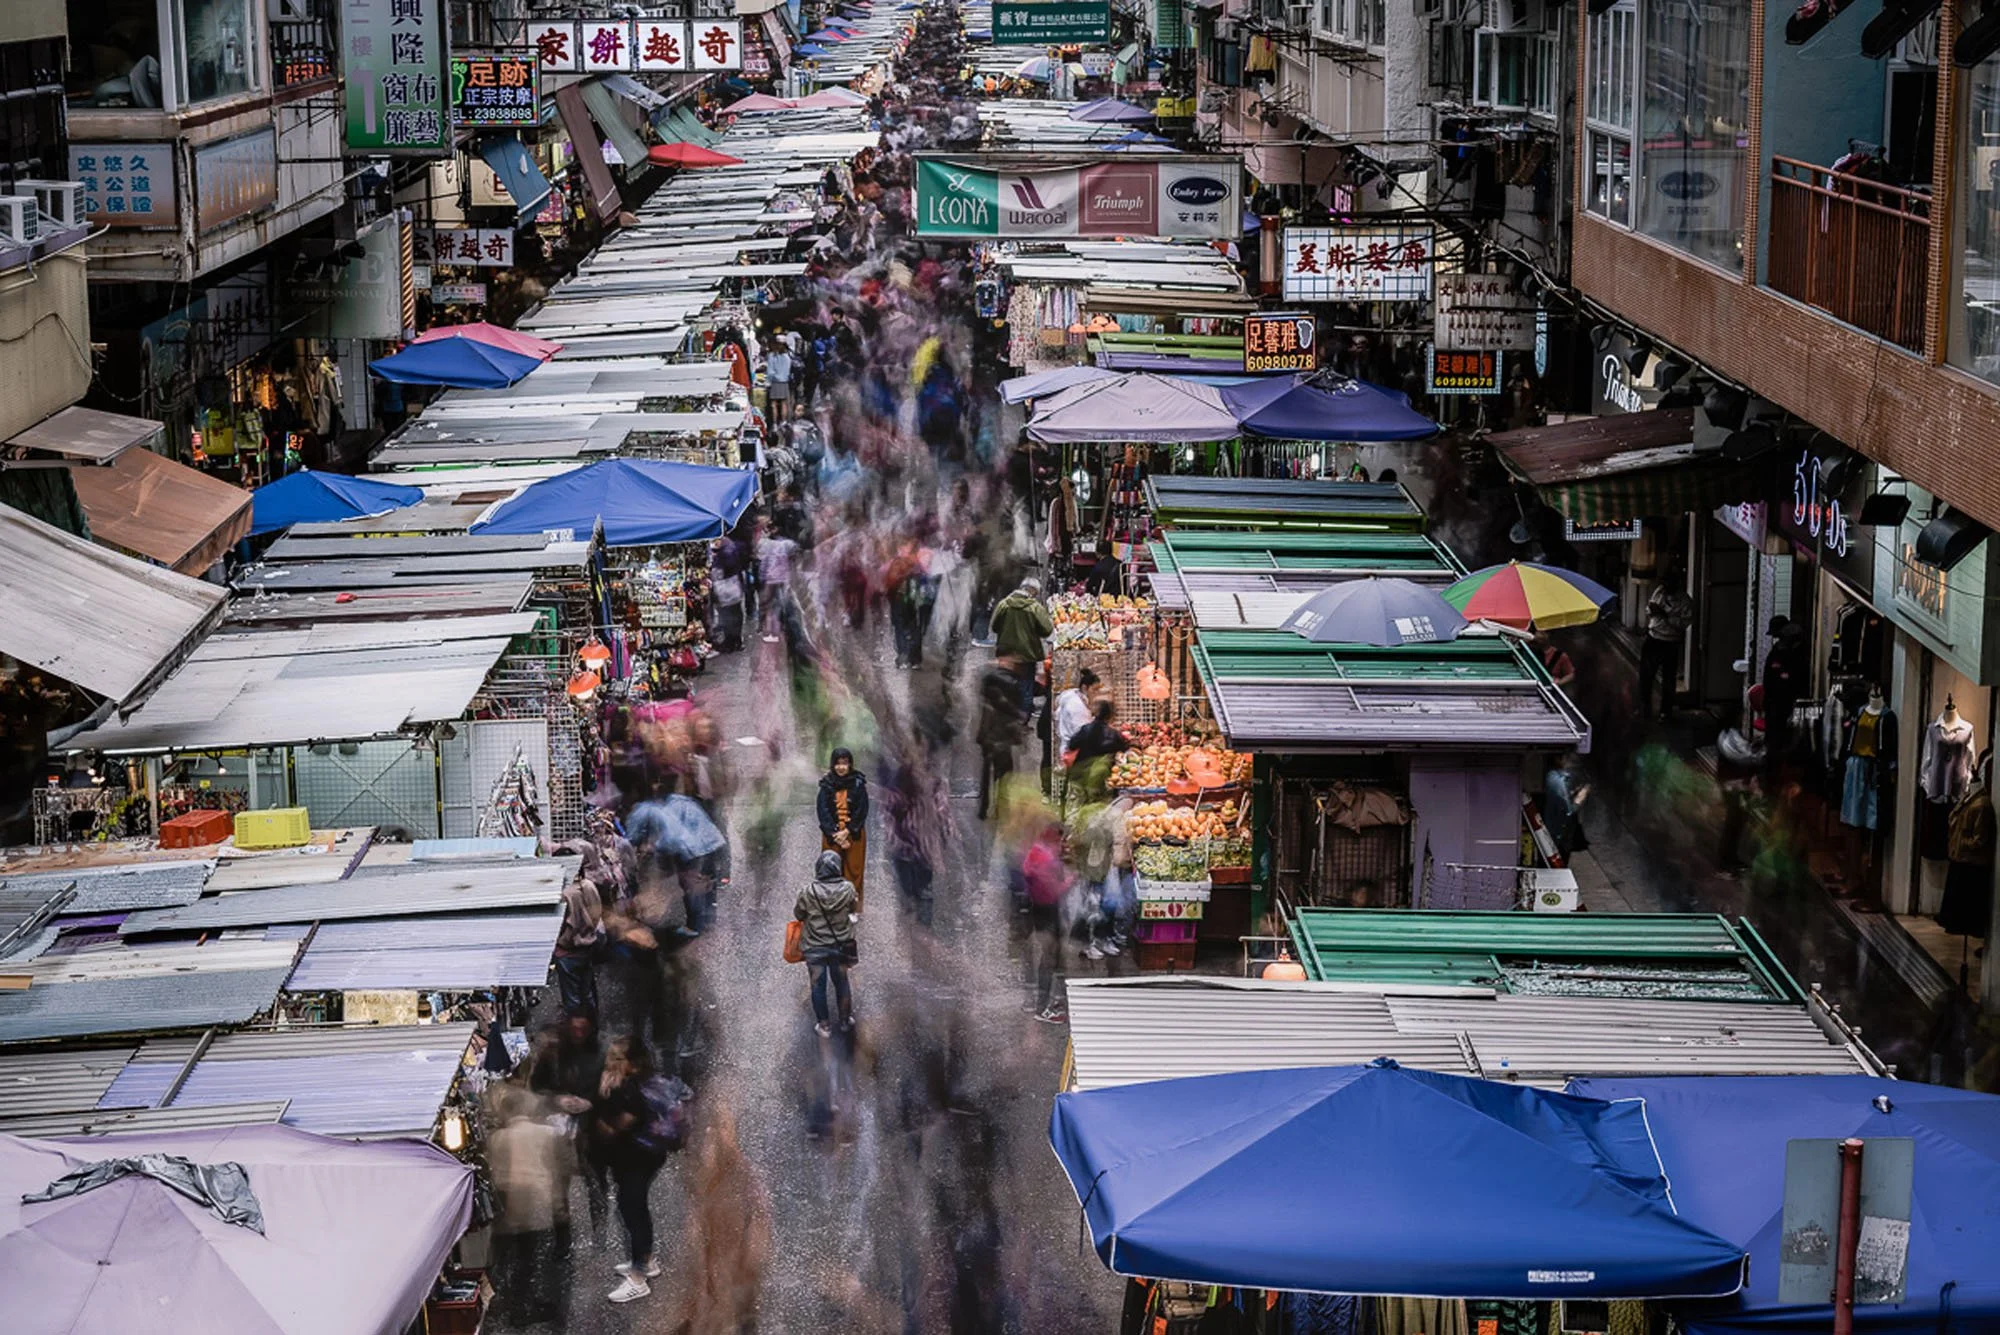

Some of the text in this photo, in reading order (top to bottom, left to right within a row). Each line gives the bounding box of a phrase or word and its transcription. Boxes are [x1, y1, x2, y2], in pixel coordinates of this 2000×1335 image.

[929, 196, 989, 226] LEONA
[1094, 195, 1144, 211] Triumph
[1249, 354, 1314, 371] 60980978
[1435, 377, 1493, 387] 60980978
